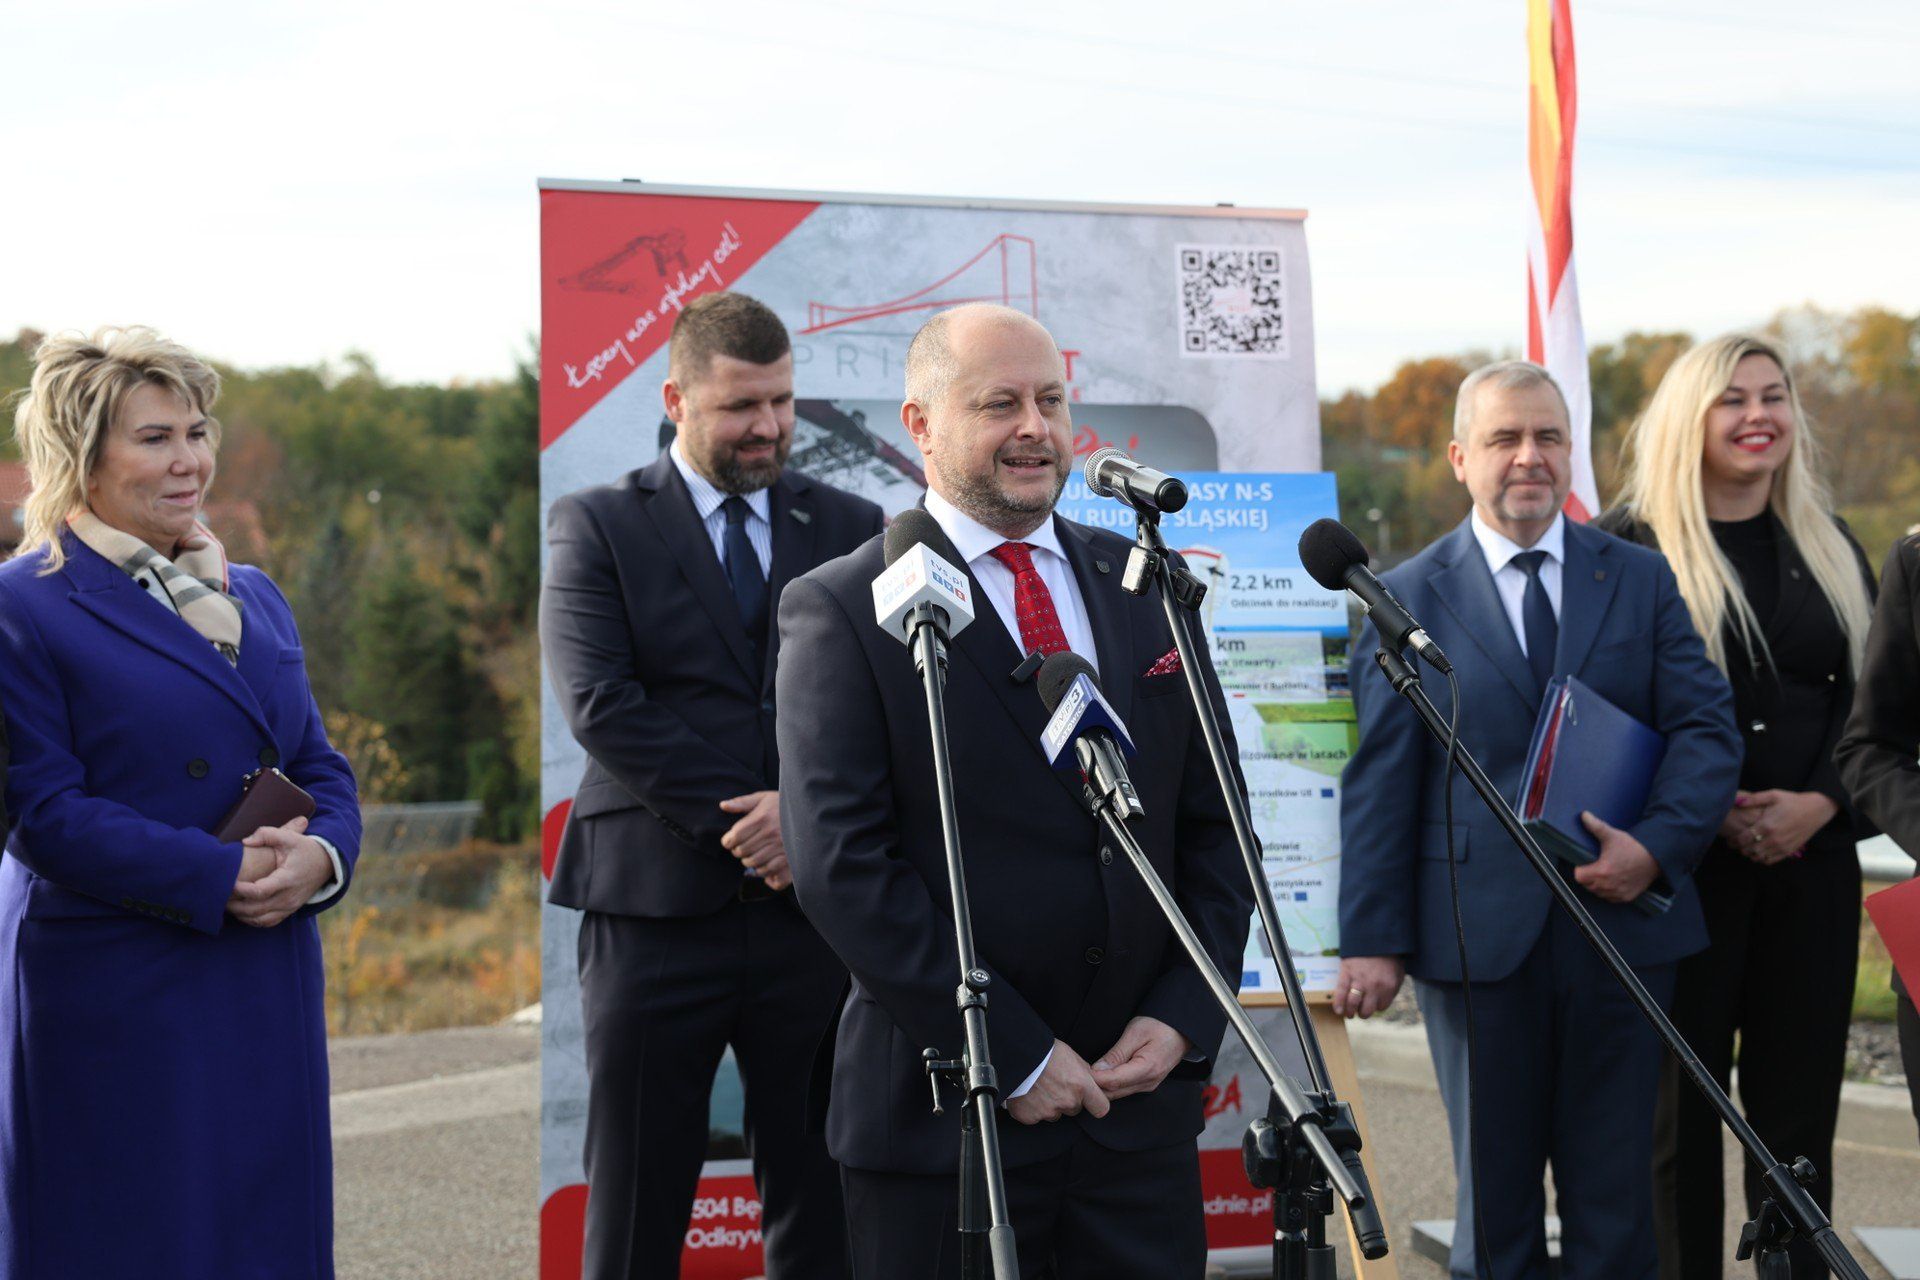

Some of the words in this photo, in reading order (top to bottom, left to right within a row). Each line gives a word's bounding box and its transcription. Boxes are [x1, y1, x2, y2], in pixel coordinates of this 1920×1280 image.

[625, 309, 658, 342] nas
[1188, 482, 1228, 501] ASY
[1235, 482, 1274, 501] N-S
[1231, 575, 1258, 591] 2,2
[1262, 574, 1293, 590] km
[1276, 599, 1290, 608] do
[1292, 599, 1339, 610] realizacji
[1216, 637, 1246, 652] km
[1311, 750, 1347, 760] latach
